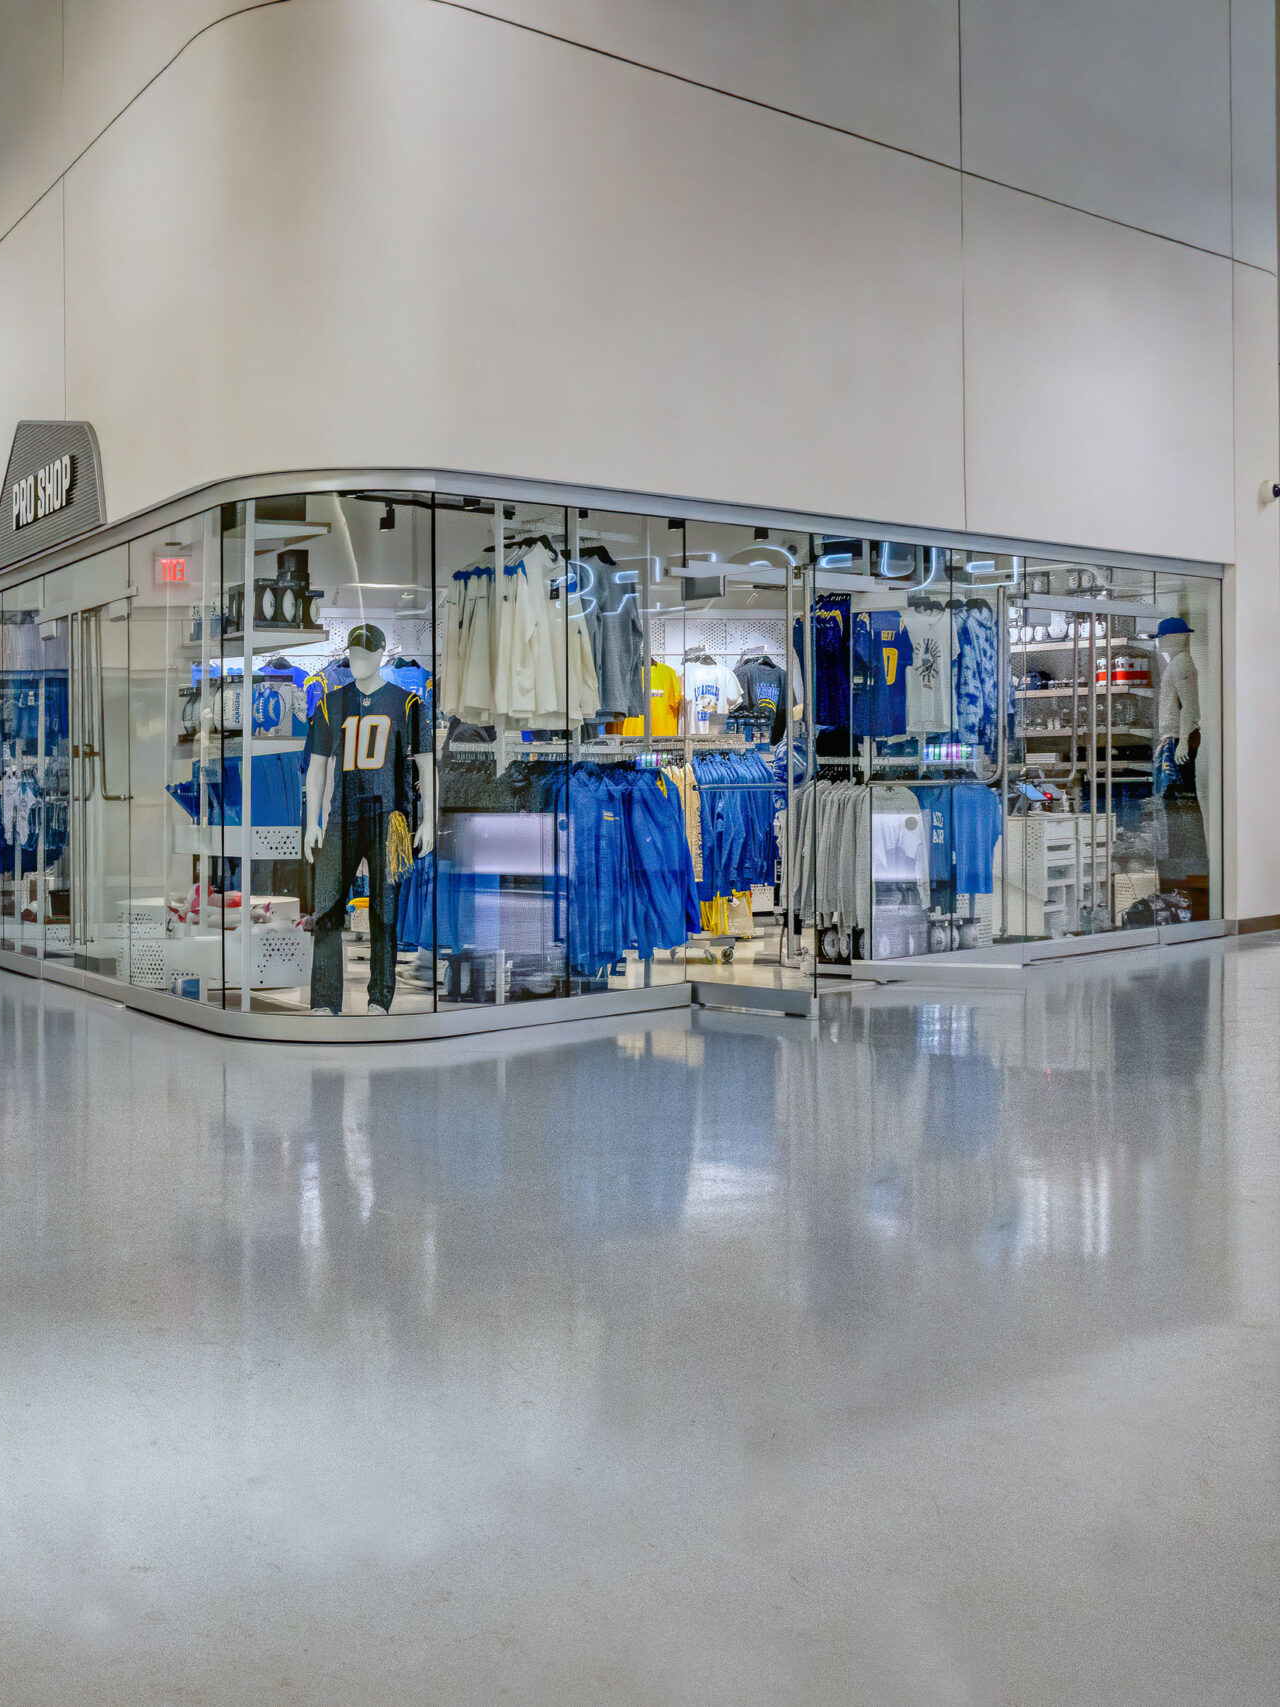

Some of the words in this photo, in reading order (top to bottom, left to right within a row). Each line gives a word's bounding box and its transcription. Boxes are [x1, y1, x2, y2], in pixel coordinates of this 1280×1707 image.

[13, 474, 35, 531] PRO
[37, 454, 71, 519] SHOP
[341, 714, 392, 772] 10
